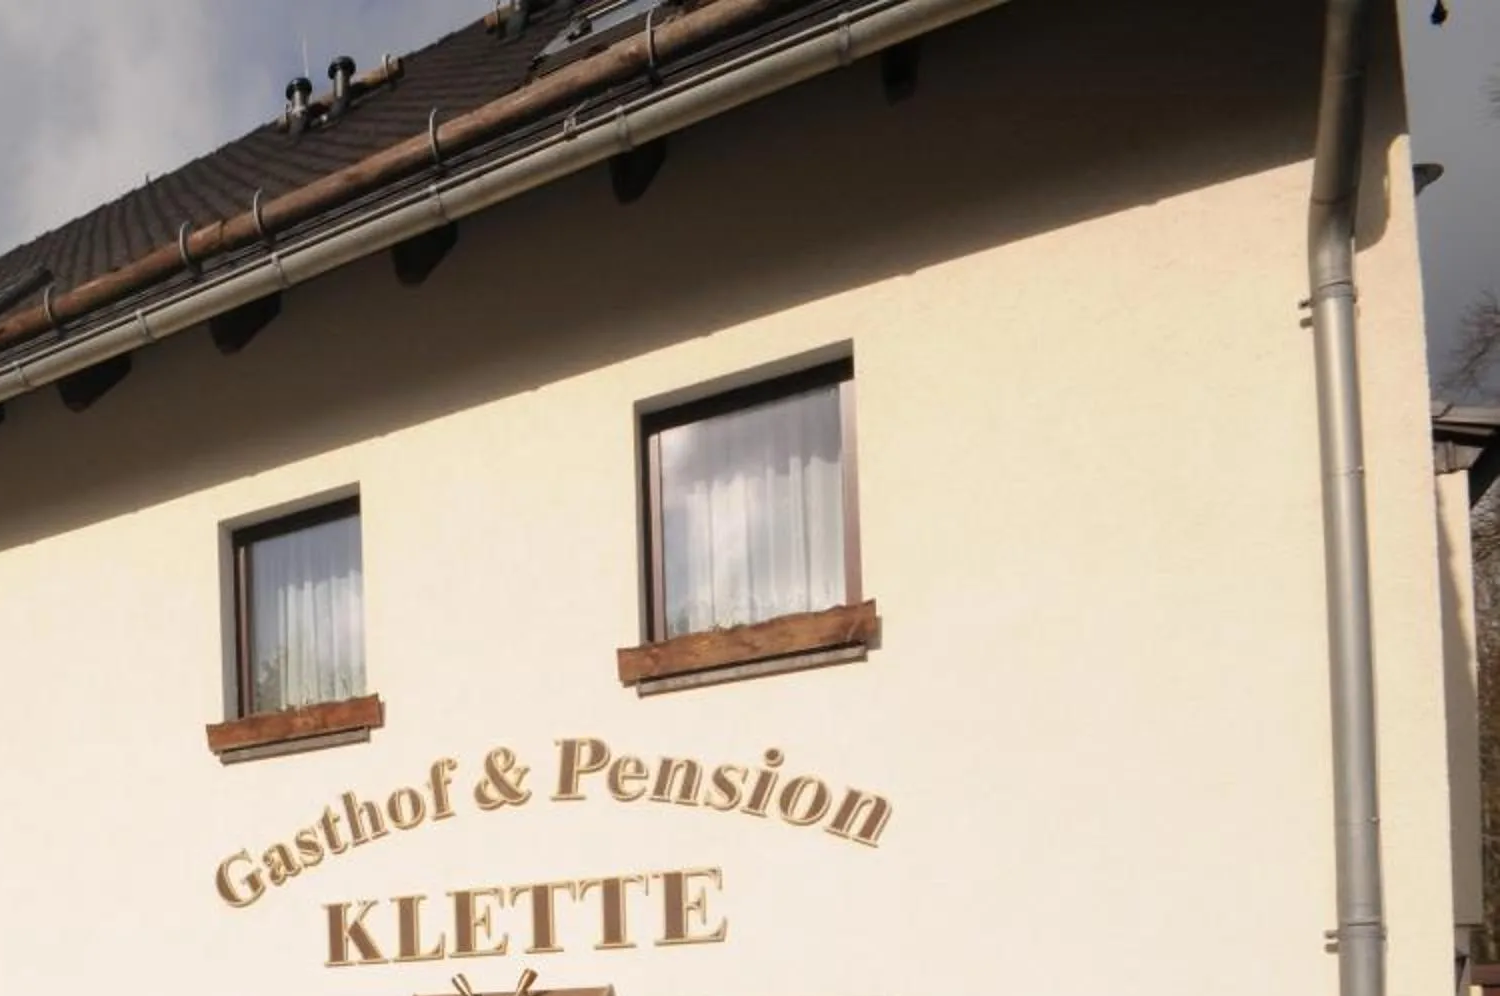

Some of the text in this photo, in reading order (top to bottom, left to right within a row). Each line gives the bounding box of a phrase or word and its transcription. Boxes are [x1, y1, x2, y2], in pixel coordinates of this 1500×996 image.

[214, 736, 897, 907] Gasthof & Pension
[323, 867, 729, 968] KLETTE
